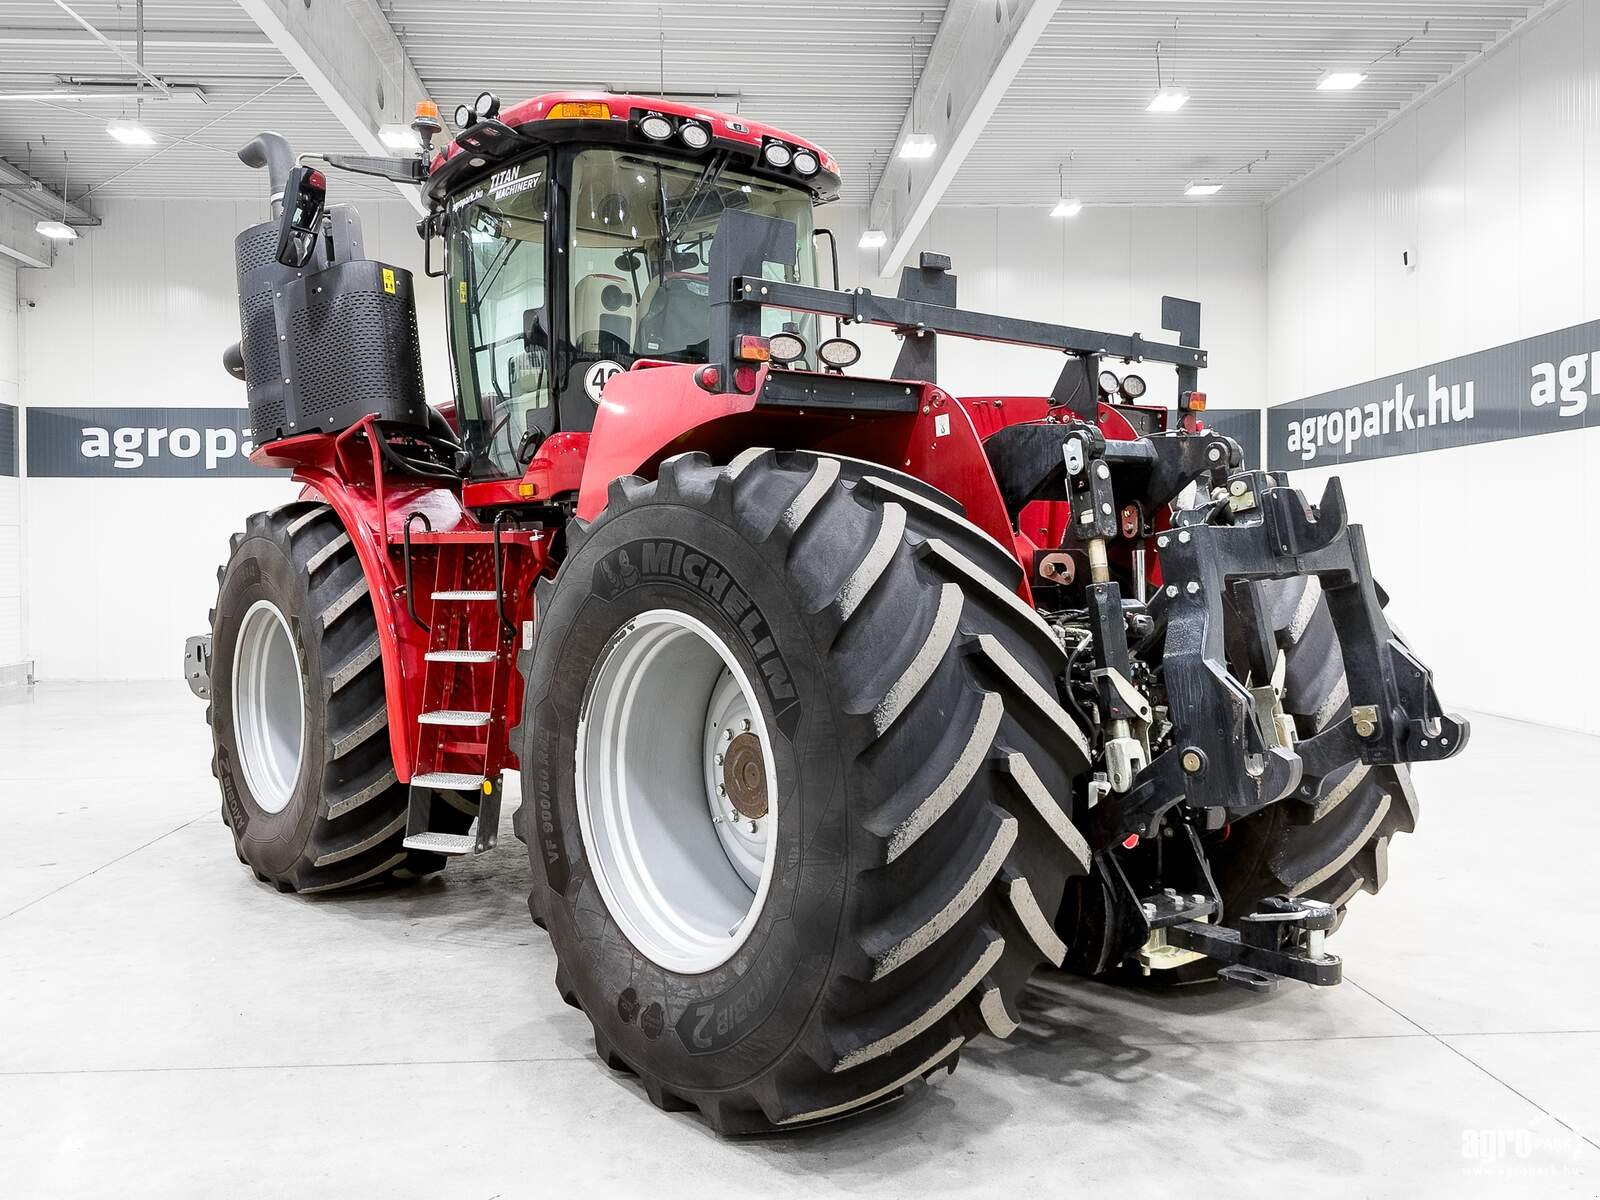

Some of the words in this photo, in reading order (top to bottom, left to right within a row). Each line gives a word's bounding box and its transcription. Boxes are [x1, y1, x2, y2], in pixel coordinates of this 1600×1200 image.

[490, 165, 520, 188] TITAN
[495, 177, 540, 200] MACHINERY
[1286, 374, 1474, 461] agropark.hu
[641, 542, 796, 700] MICHELIN
[692, 1004, 714, 1049] 2
